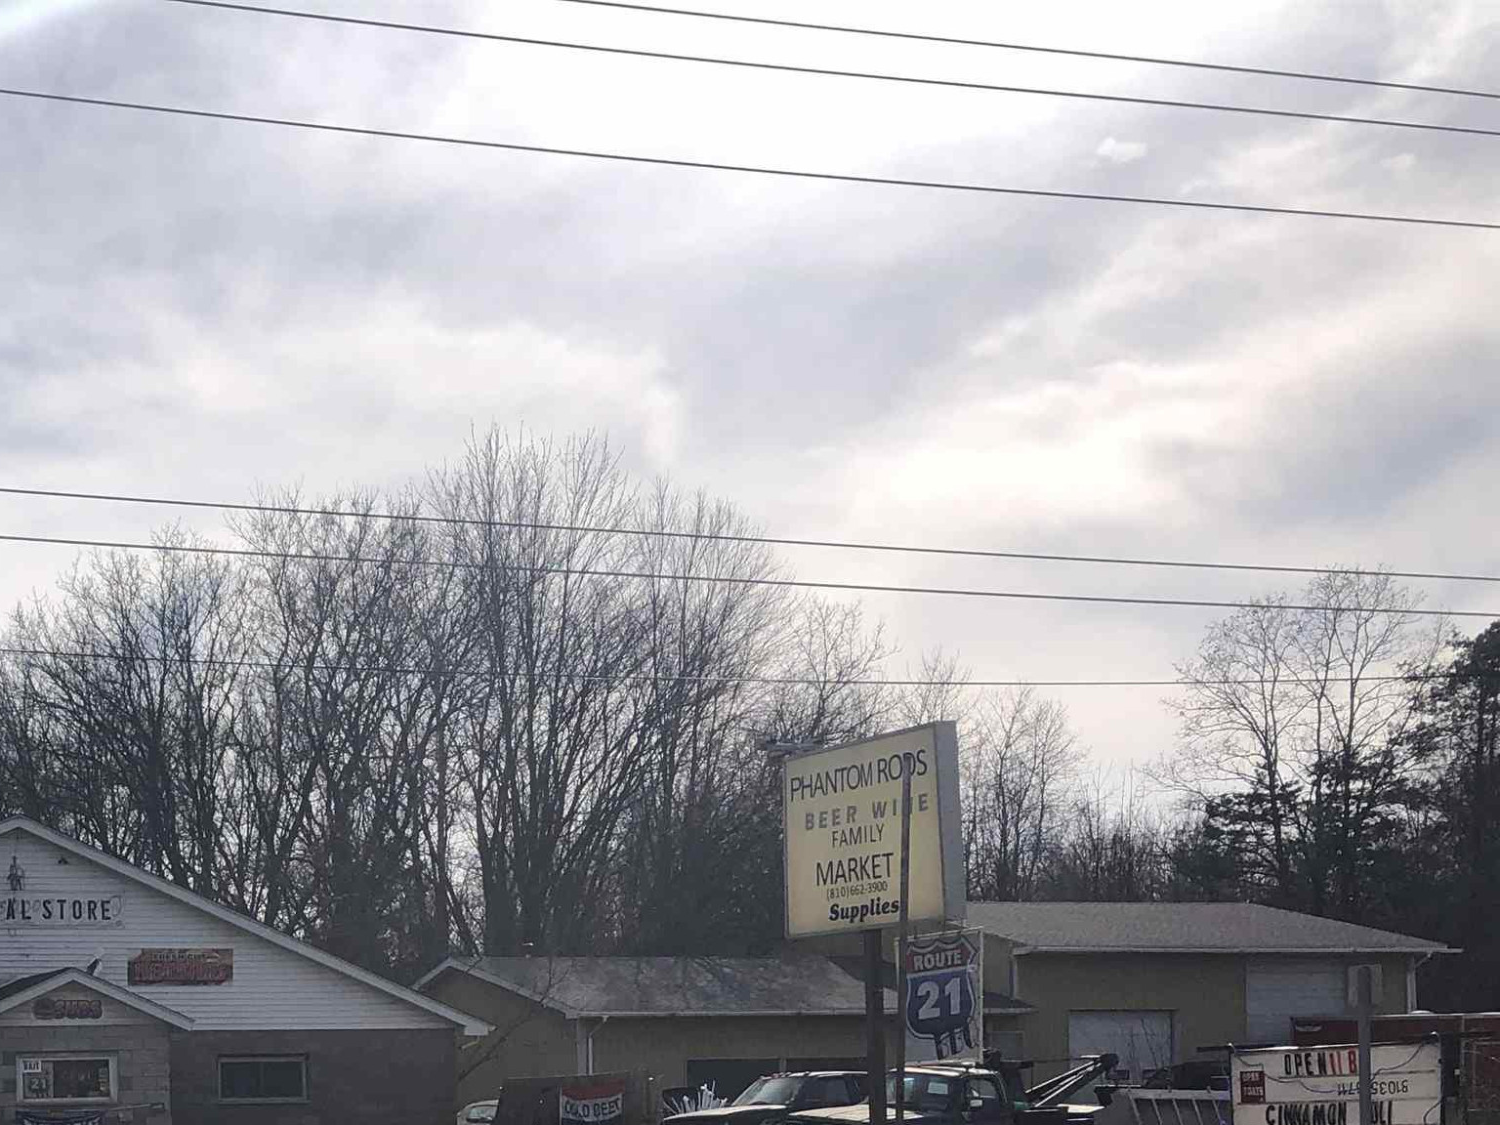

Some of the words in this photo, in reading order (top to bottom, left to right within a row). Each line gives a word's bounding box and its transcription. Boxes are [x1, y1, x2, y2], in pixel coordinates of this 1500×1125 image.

[790, 762, 873, 802] PHANTOM
[877, 749, 928, 784] RODS
[805, 805, 857, 830] BEER
[872, 793, 929, 820] WIE
[831, 823, 885, 848] FAMILY
[816, 852, 894, 887] MARKET
[41, 898, 112, 921] STORE
[828, 897, 900, 923] Supplies
[913, 951, 962, 971] ROUTE
[53, 1000, 102, 1019] SUBS
[917, 977, 961, 1020] 21
[1284, 1052, 1327, 1076] OPEN
[31, 1078, 47, 1089] 21
[1265, 1101, 1347, 1125] CINNAMON
